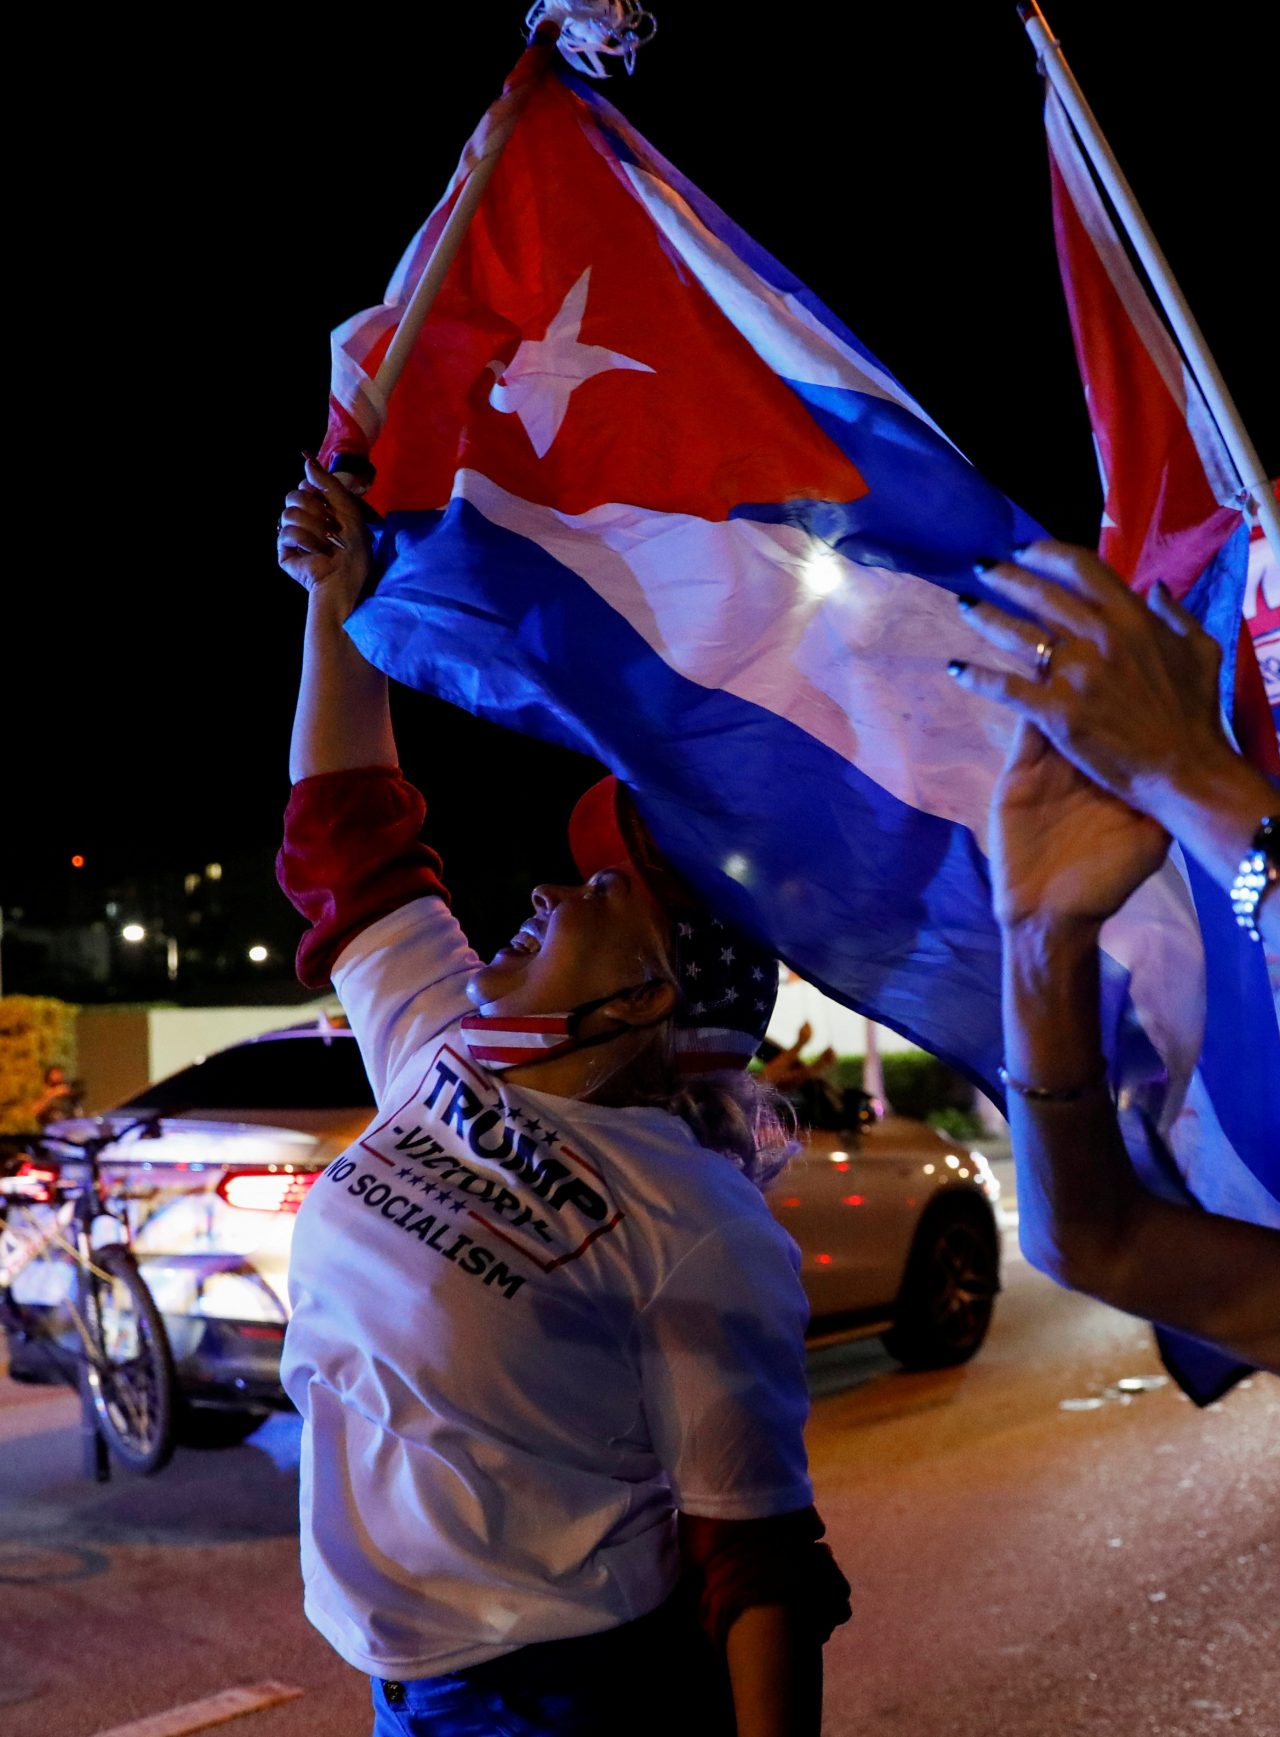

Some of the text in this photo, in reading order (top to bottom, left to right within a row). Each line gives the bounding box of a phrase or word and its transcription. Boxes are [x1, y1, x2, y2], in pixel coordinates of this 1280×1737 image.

[423, 1060, 609, 1221] TRUMP
[324, 1156, 527, 1300] NO SOCIALISM
